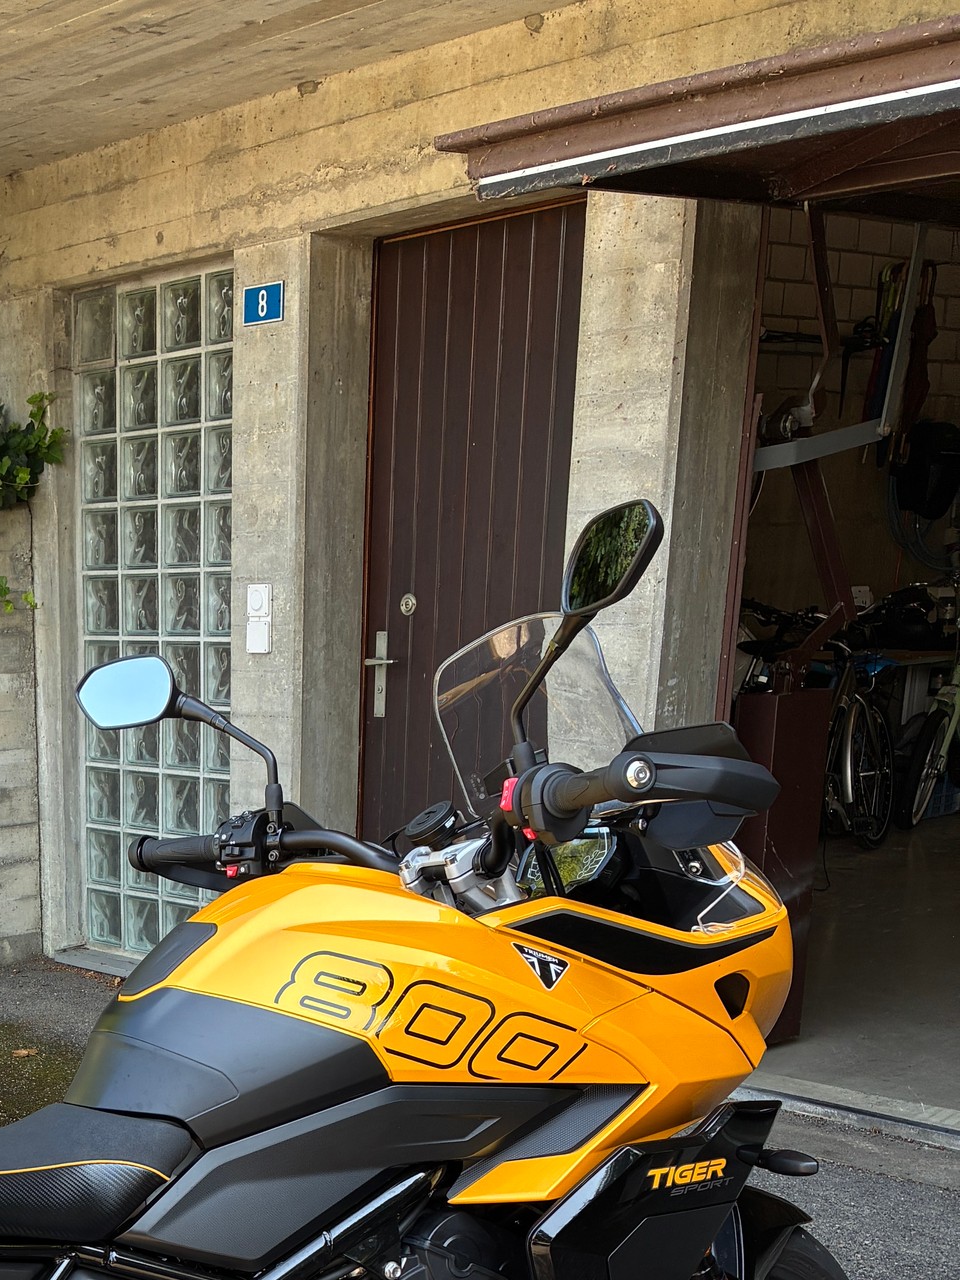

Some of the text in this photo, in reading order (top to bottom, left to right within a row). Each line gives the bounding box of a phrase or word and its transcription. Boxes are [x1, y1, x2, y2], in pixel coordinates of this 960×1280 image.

[258, 290, 267, 317] 8
[523, 947, 559, 964] TRIUMPH
[274, 950, 588, 1081] 800
[646, 1158, 727, 1190] TIGER
[670, 1176, 735, 1197] SPORT
